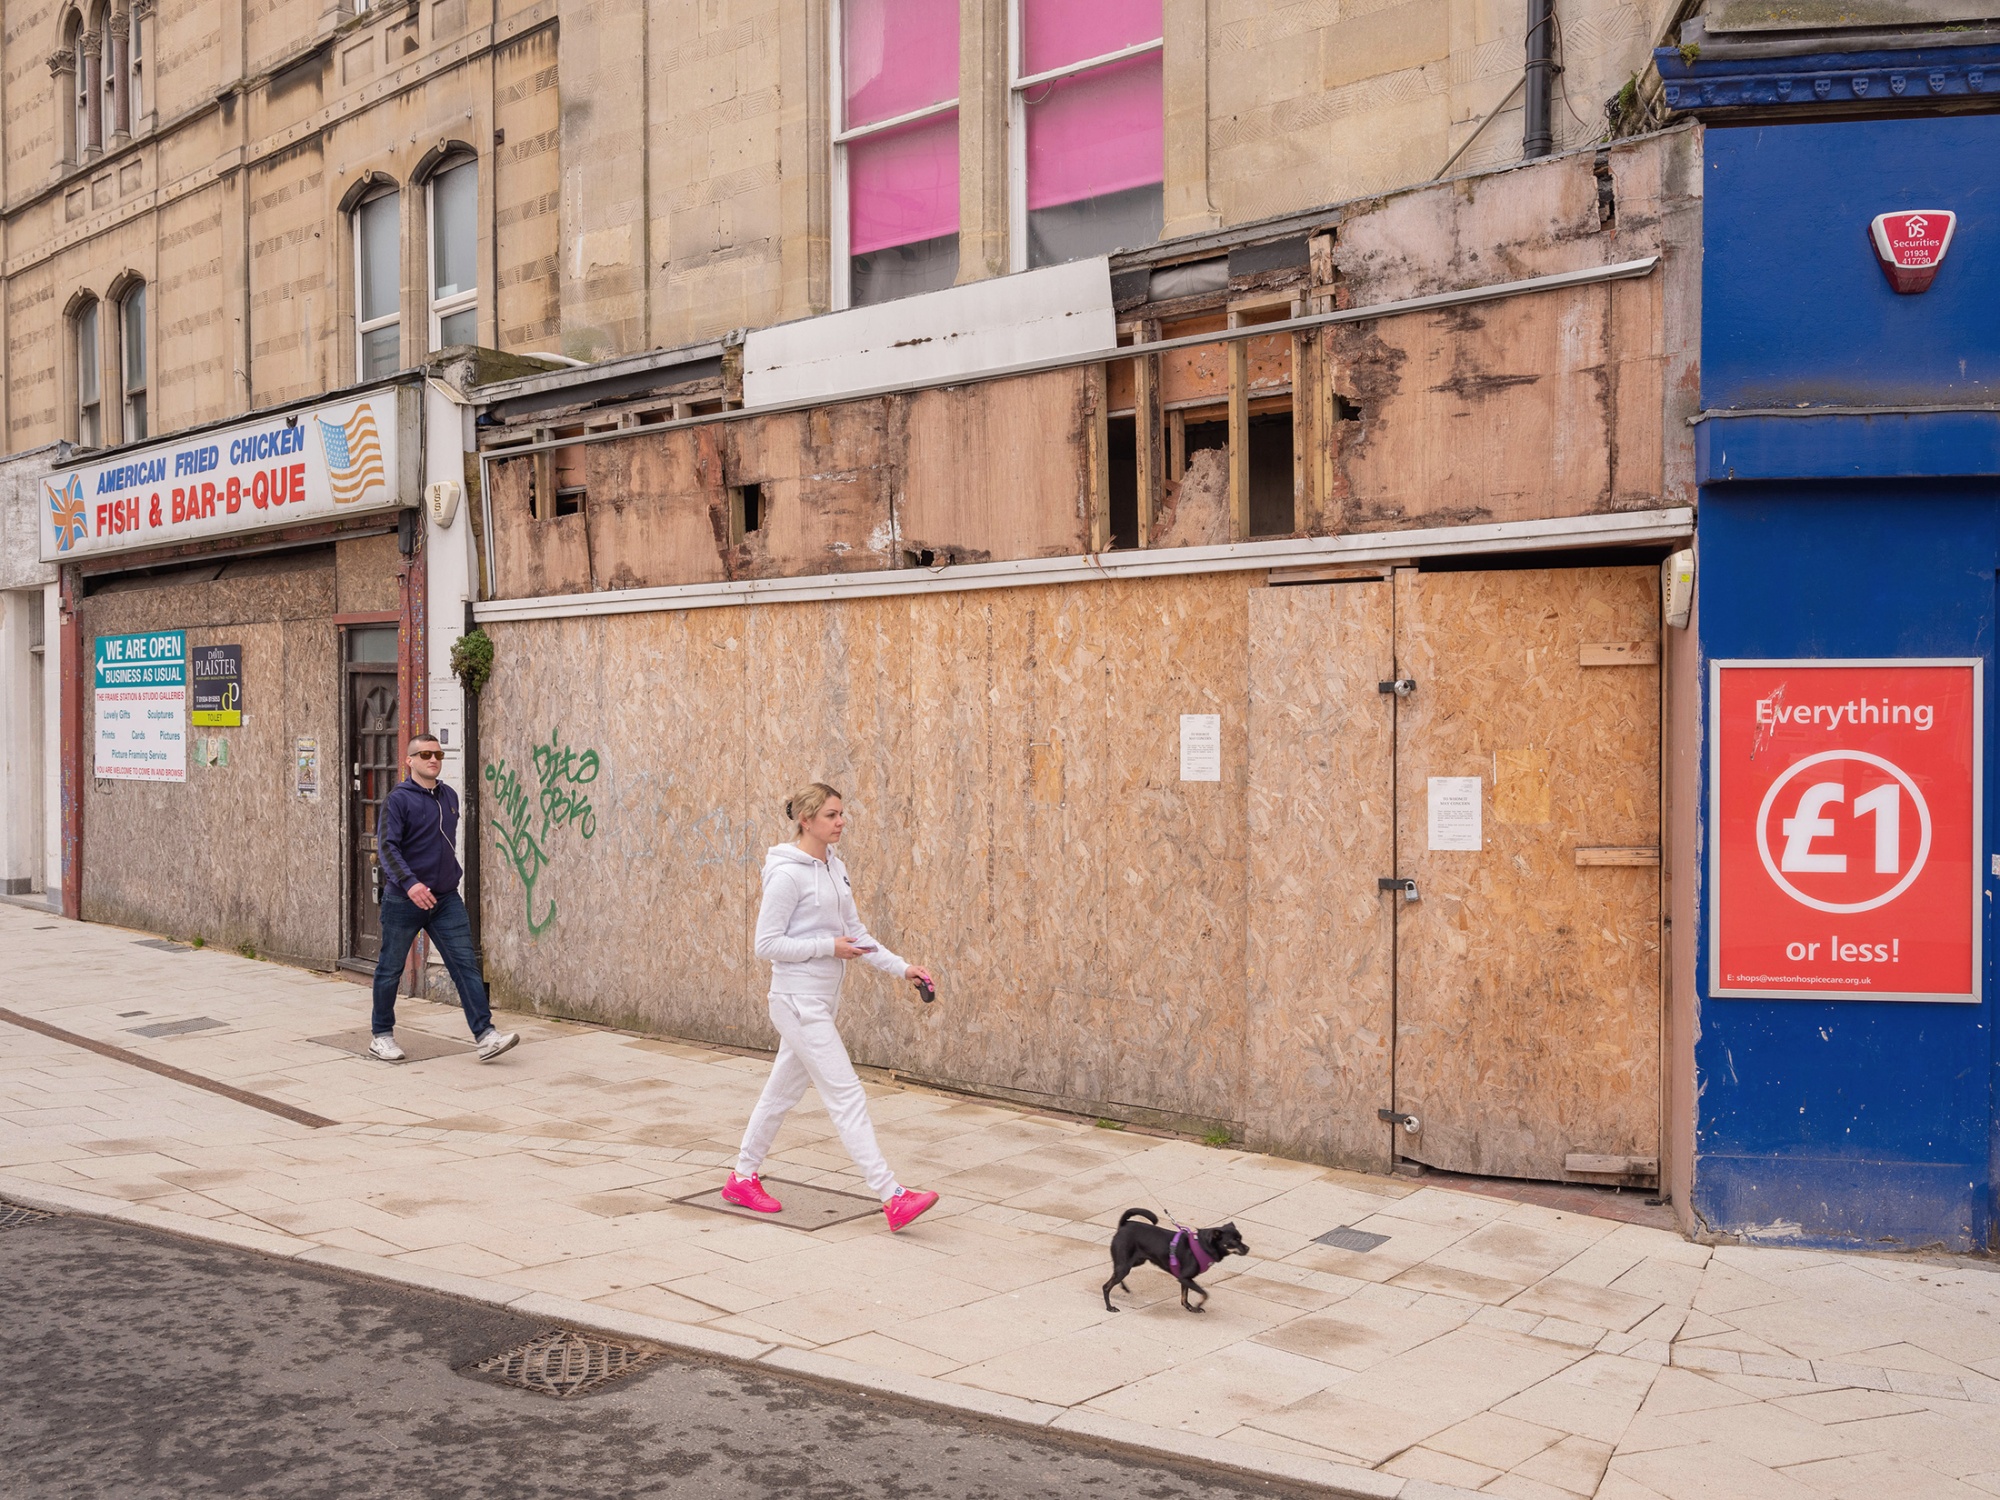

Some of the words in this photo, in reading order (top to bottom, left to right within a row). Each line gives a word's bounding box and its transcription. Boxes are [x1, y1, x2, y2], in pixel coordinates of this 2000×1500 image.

[1894, 239, 1940, 248] Securities
[97, 458, 166, 495] AMERICAN
[175, 445, 219, 478] FRIED
[229, 425, 305, 465] CHICKEN
[97, 497, 139, 537] FISH
[149, 492, 163, 528] &
[172, 463, 305, 524] BAR-B-QUE
[106, 640, 122, 660] WE
[125, 638, 146, 659] ARE
[149, 636, 181, 658] OPEN
[208, 650, 224, 659] DAVID
[196, 659, 237, 676] PLAISTER
[106, 669, 141, 683] BUSINESS
[143, 668, 153, 682] AS
[154, 667, 181, 682] USUAL
[120, 692, 137, 700] STATION
[142, 692, 158, 700] STUDIO
[159, 691, 184, 700] GALLERIES
[104, 711, 118, 720] Lovely
[120, 710, 130, 719] Gifts
[148, 710, 174, 720] Sculptures
[1756, 698, 1934, 731] Everything
[102, 730, 115, 739] Prints
[132, 730, 145, 740] Cards
[160, 731, 180, 740] Pictures
[112, 749, 127, 758] Picture
[129, 750, 148, 761] Framing
[149, 750, 167, 760] Service
[1781, 782, 1899, 873] £1
[1786, 941, 1820, 962] or
[1831, 935, 1899, 962] less!
[1736, 974, 1871, 985] shops@westonhospicecare.org.uk
